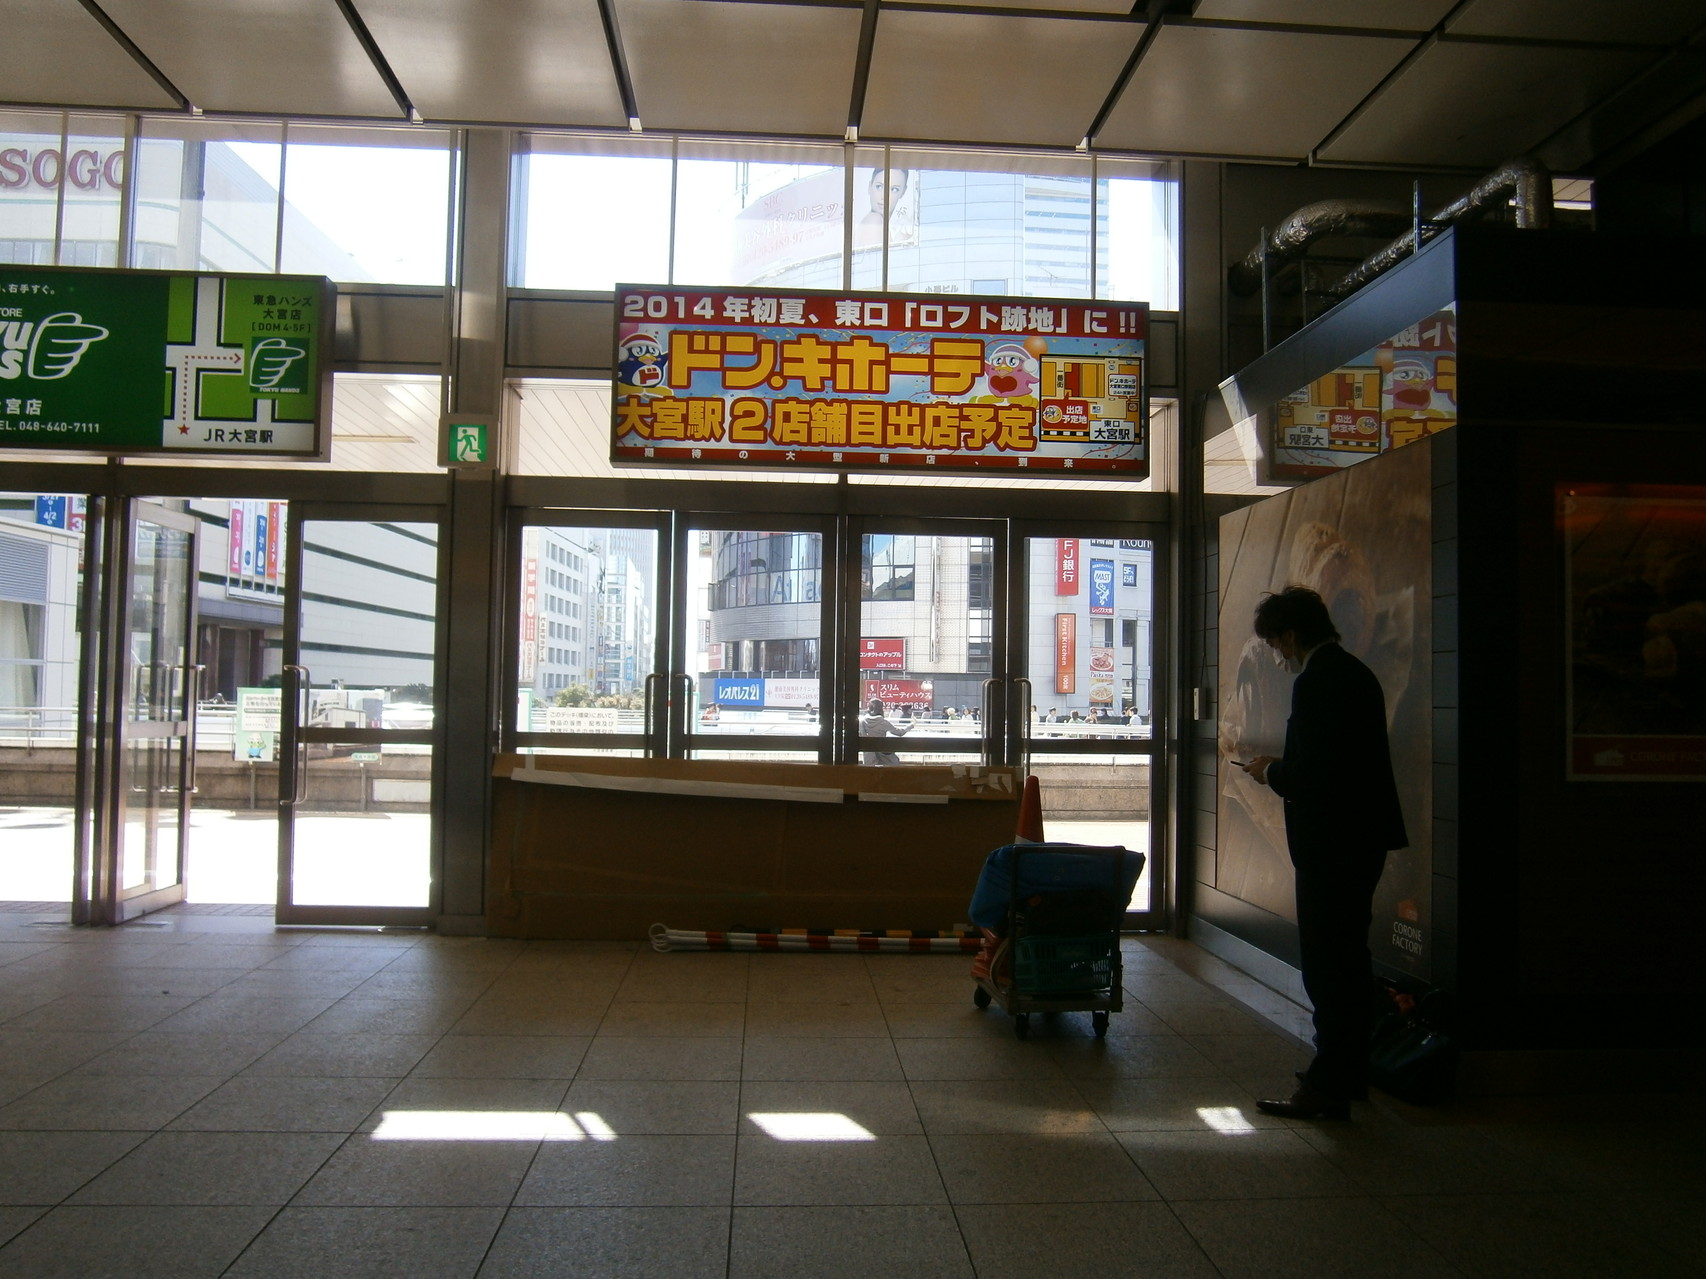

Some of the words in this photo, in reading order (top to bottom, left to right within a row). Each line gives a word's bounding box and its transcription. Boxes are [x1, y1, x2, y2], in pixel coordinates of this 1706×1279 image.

[253, 295, 313, 306] 東急ハンズ
[263, 309, 302, 320] 大宮店
[0, 398, 42, 415] 宮店
[1066, 405, 1083, 414] 出店
[615, 397, 1036, 449] 大宮駅2店舗目出店予定
[1062, 415, 1087, 424] 予定地
[1103, 420, 1120, 428] 東口
[203, 428, 273, 444] JR大宮駅
[1094, 428, 1130, 440] 大宮駅
[719, 683, 760, 701] レオパレス21
[880, 691, 932, 699] ビューティハウス
[1393, 921, 1422, 942] CORONE
[1392, 933, 1423, 956] FACTORY
